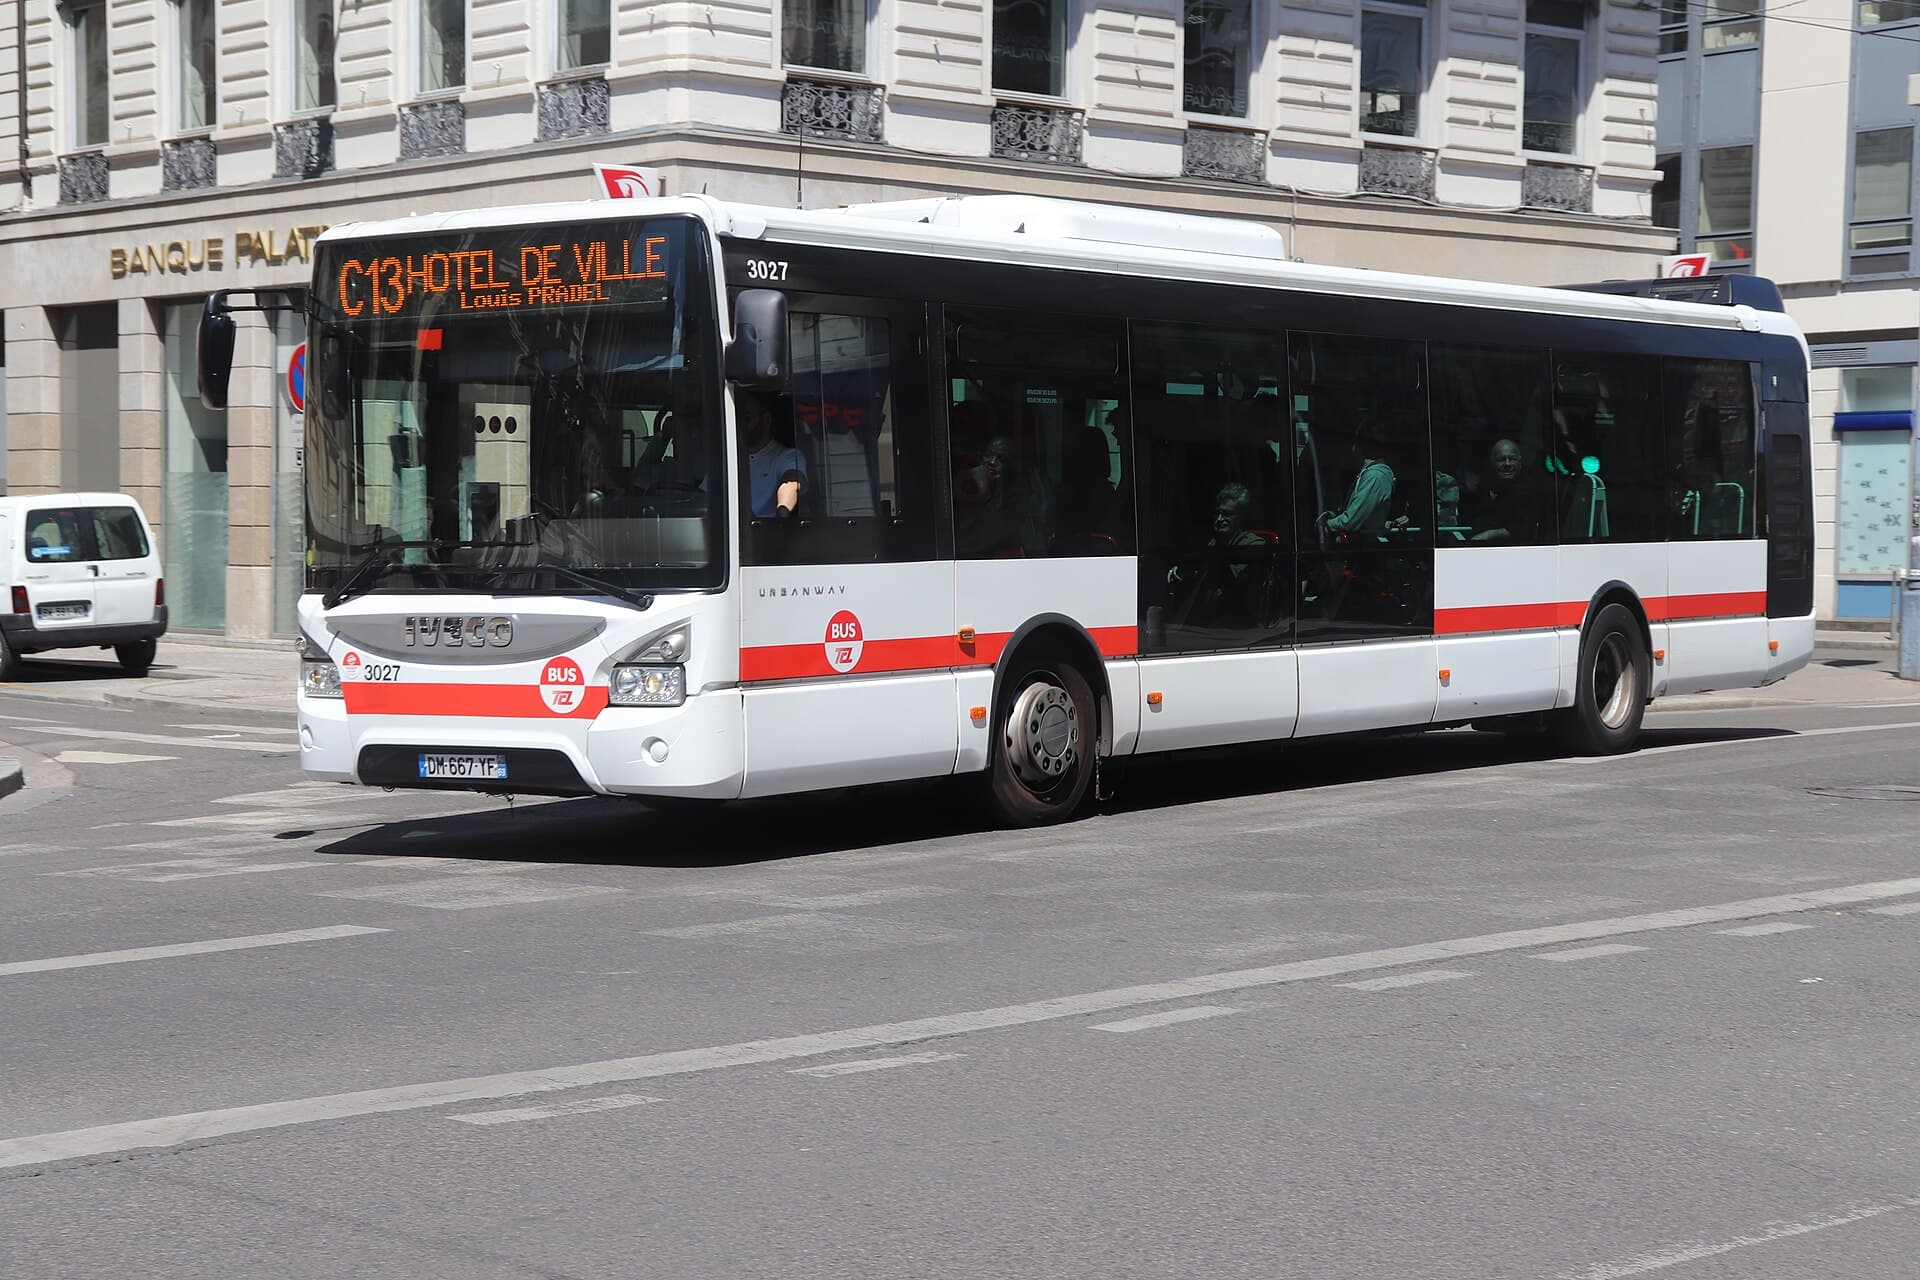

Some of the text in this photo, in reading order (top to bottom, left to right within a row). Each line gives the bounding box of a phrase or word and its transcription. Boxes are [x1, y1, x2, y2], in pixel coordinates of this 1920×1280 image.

[111, 225, 329, 279] BANQUE PALAT
[407, 236, 666, 294] HOTEL DE VILLE
[747, 259, 788, 280] 3027
[339, 256, 405, 316] C13
[460, 283, 610, 310] Louis PRADEL
[405, 616, 514, 648] IVECO
[831, 622, 856, 639] BUS
[364, 664, 400, 681] 3027
[547, 667, 577, 683] BUS
